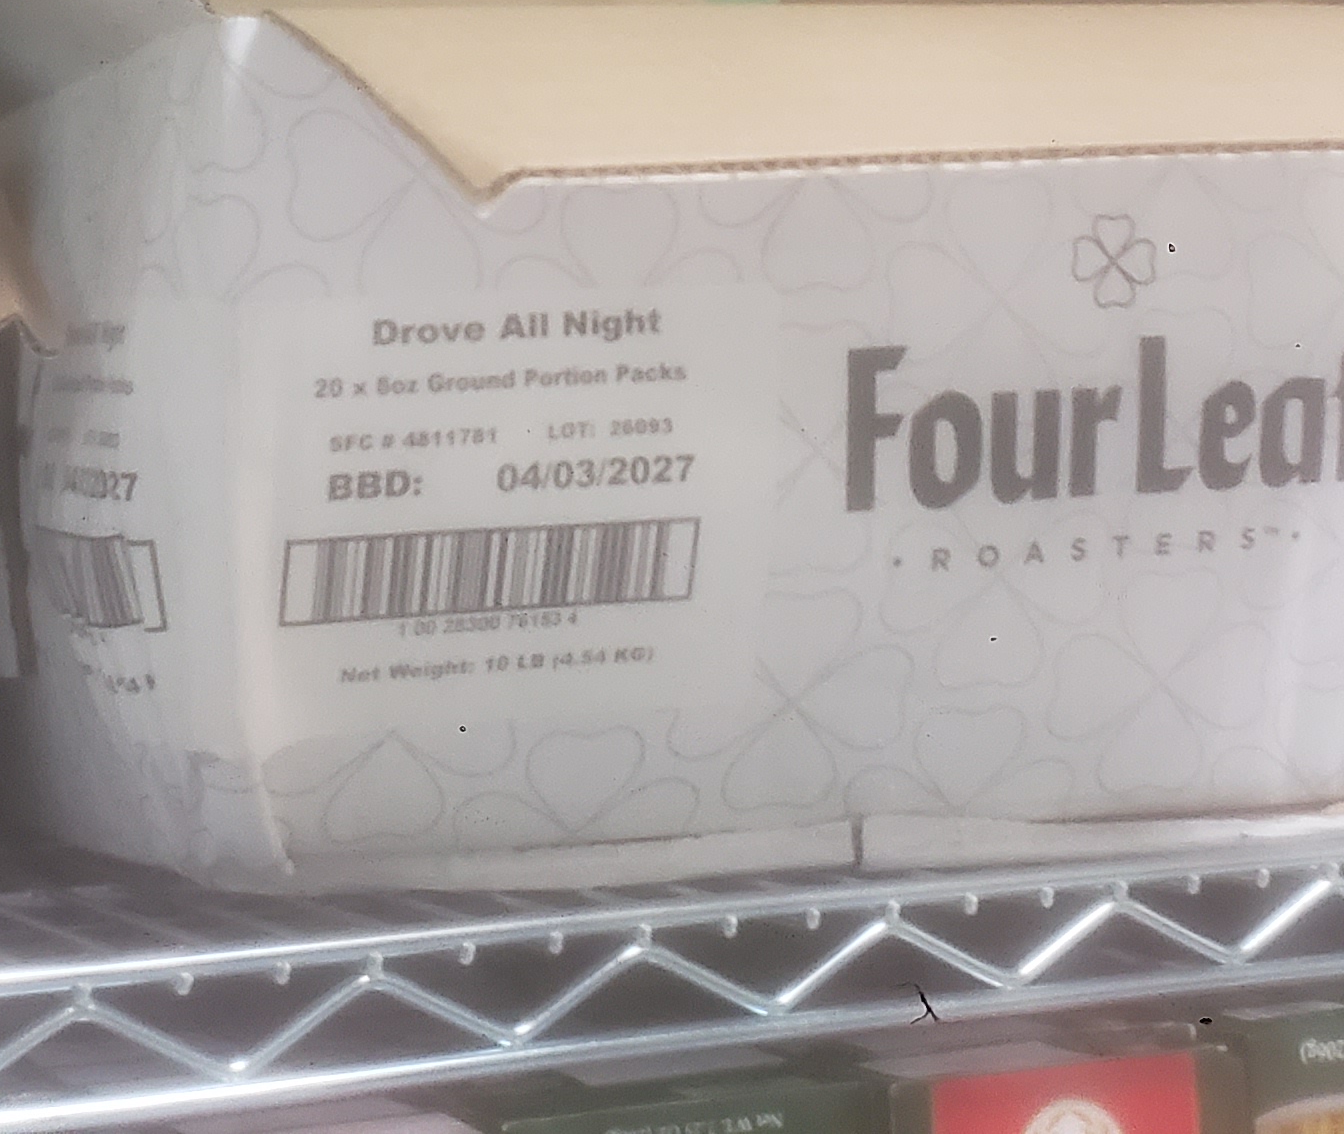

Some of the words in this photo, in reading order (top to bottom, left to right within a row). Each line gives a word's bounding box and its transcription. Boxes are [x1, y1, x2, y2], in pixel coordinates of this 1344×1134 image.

[372, 318, 486, 346] Drove
[499, 312, 550, 340] All
[561, 308, 663, 342] Night
[314, 377, 344, 399] 20
[426, 369, 517, 394] Ground
[523, 366, 607, 388] Portion
[614, 363, 688, 383] Packs
[327, 469, 424, 502] BBD:
[495, 452, 696, 493] 04/03/2027
[339, 666, 382, 684] Net
[388, 660, 475, 683] Weight:
[484, 655, 508, 672] 10
[516, 652, 546, 670] LB
